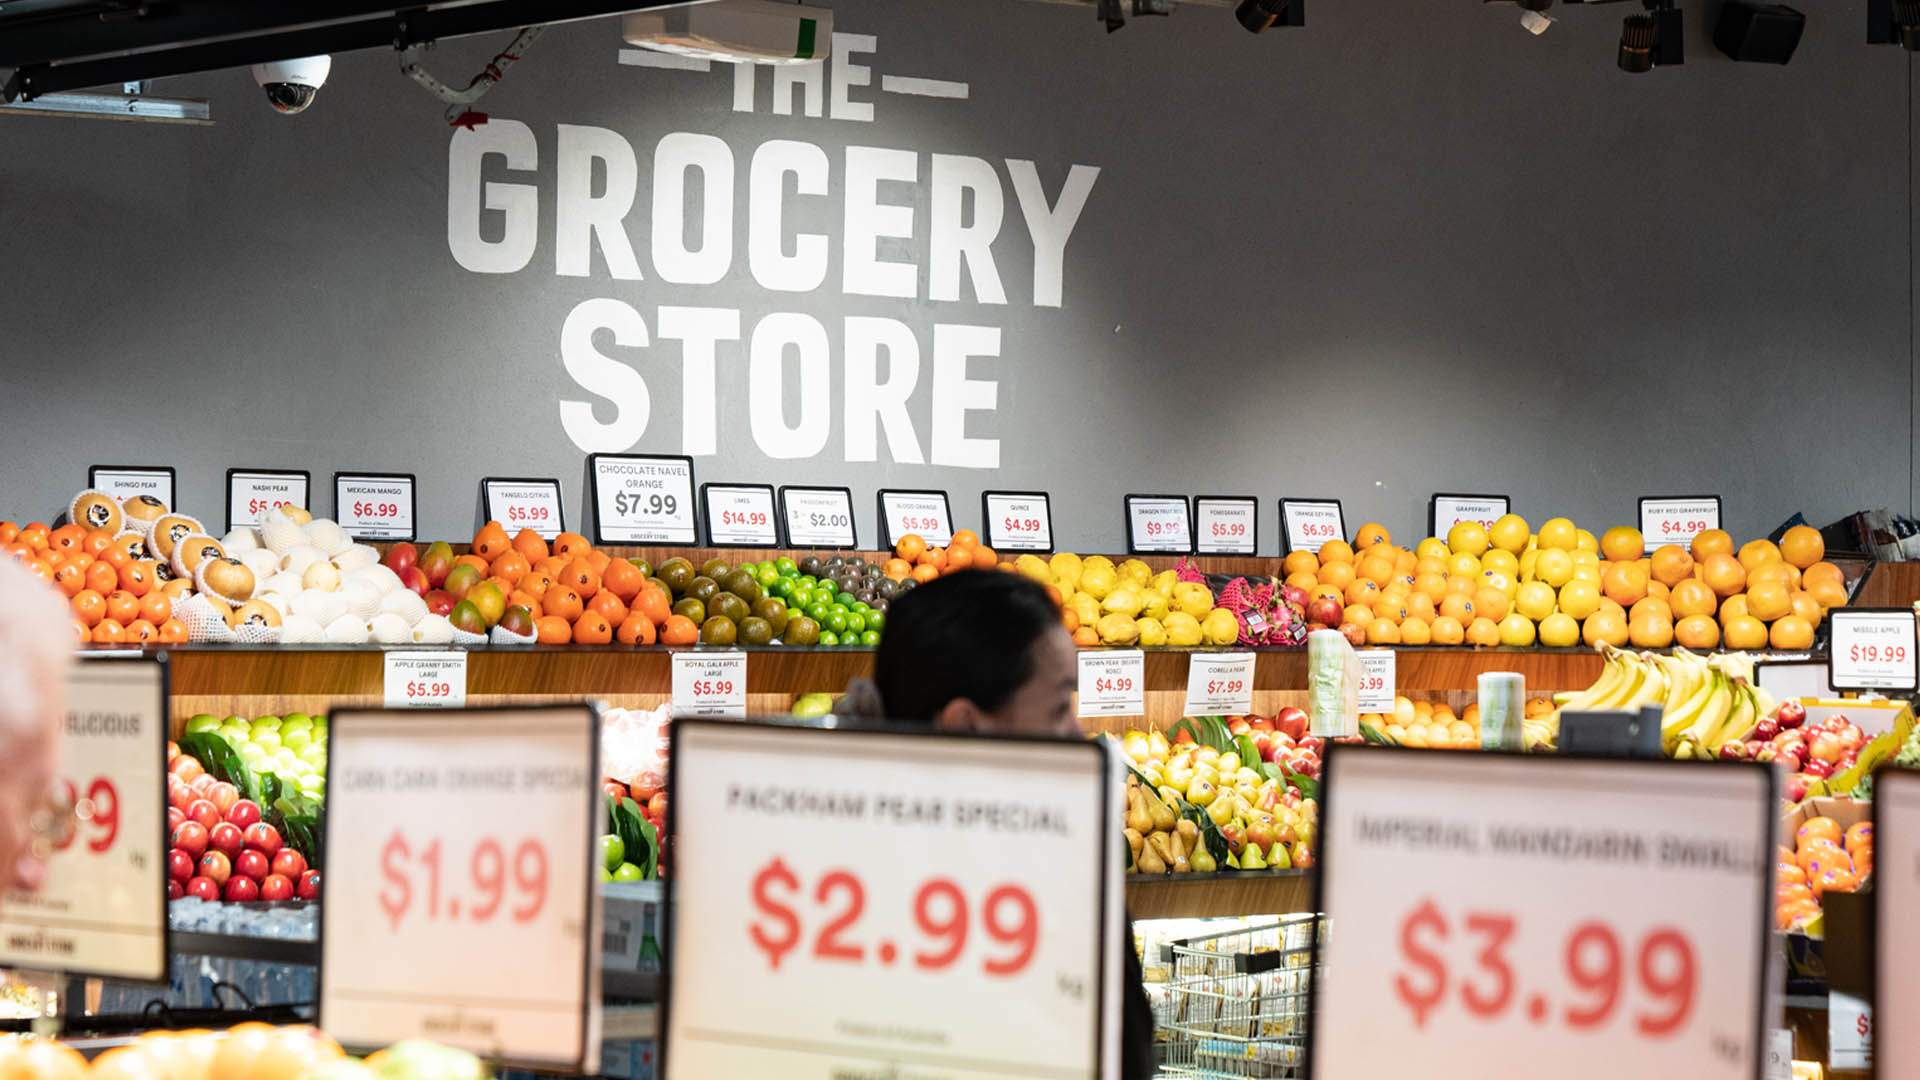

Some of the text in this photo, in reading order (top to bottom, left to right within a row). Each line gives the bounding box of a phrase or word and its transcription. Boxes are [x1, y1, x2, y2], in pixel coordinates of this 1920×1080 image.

[448, 118, 1101, 308] GROCERY
[559, 298, 1001, 469] STORE
[599, 464, 688, 476] CHOCOLATE NAVEL
[625, 479, 664, 488] ORANGE
[353, 501, 398, 518] $6.99
[615, 490, 677, 517] $7.99
[508, 505, 549, 521] $5.99
[722, 510, 767, 525] $14.99
[810, 512, 848, 527] $2.00
[902, 516, 938, 530] $5.99
[1005, 517, 1040, 532] $4.99
[1146, 521, 1181, 536] $9.99
[1212, 522, 1245, 536] $5.99
[1302, 523, 1335, 536] $6.99
[1662, 521, 1707, 534] $4.99
[1850, 644, 1905, 662] $19.99
[407, 681, 450, 698] $5.99
[693, 680, 733, 696] $5.99
[1096, 677, 1132, 693] $4.99
[1207, 680, 1243, 694] $7.99
[65, 711, 142, 738] ELICIOUS
[726, 783, 1072, 837] PACKHAM PEAR SPECIAL
[377, 828, 550, 934] $1.99
[749, 855, 1040, 978] $2.99
[1392, 896, 1701, 1038] $3.99
